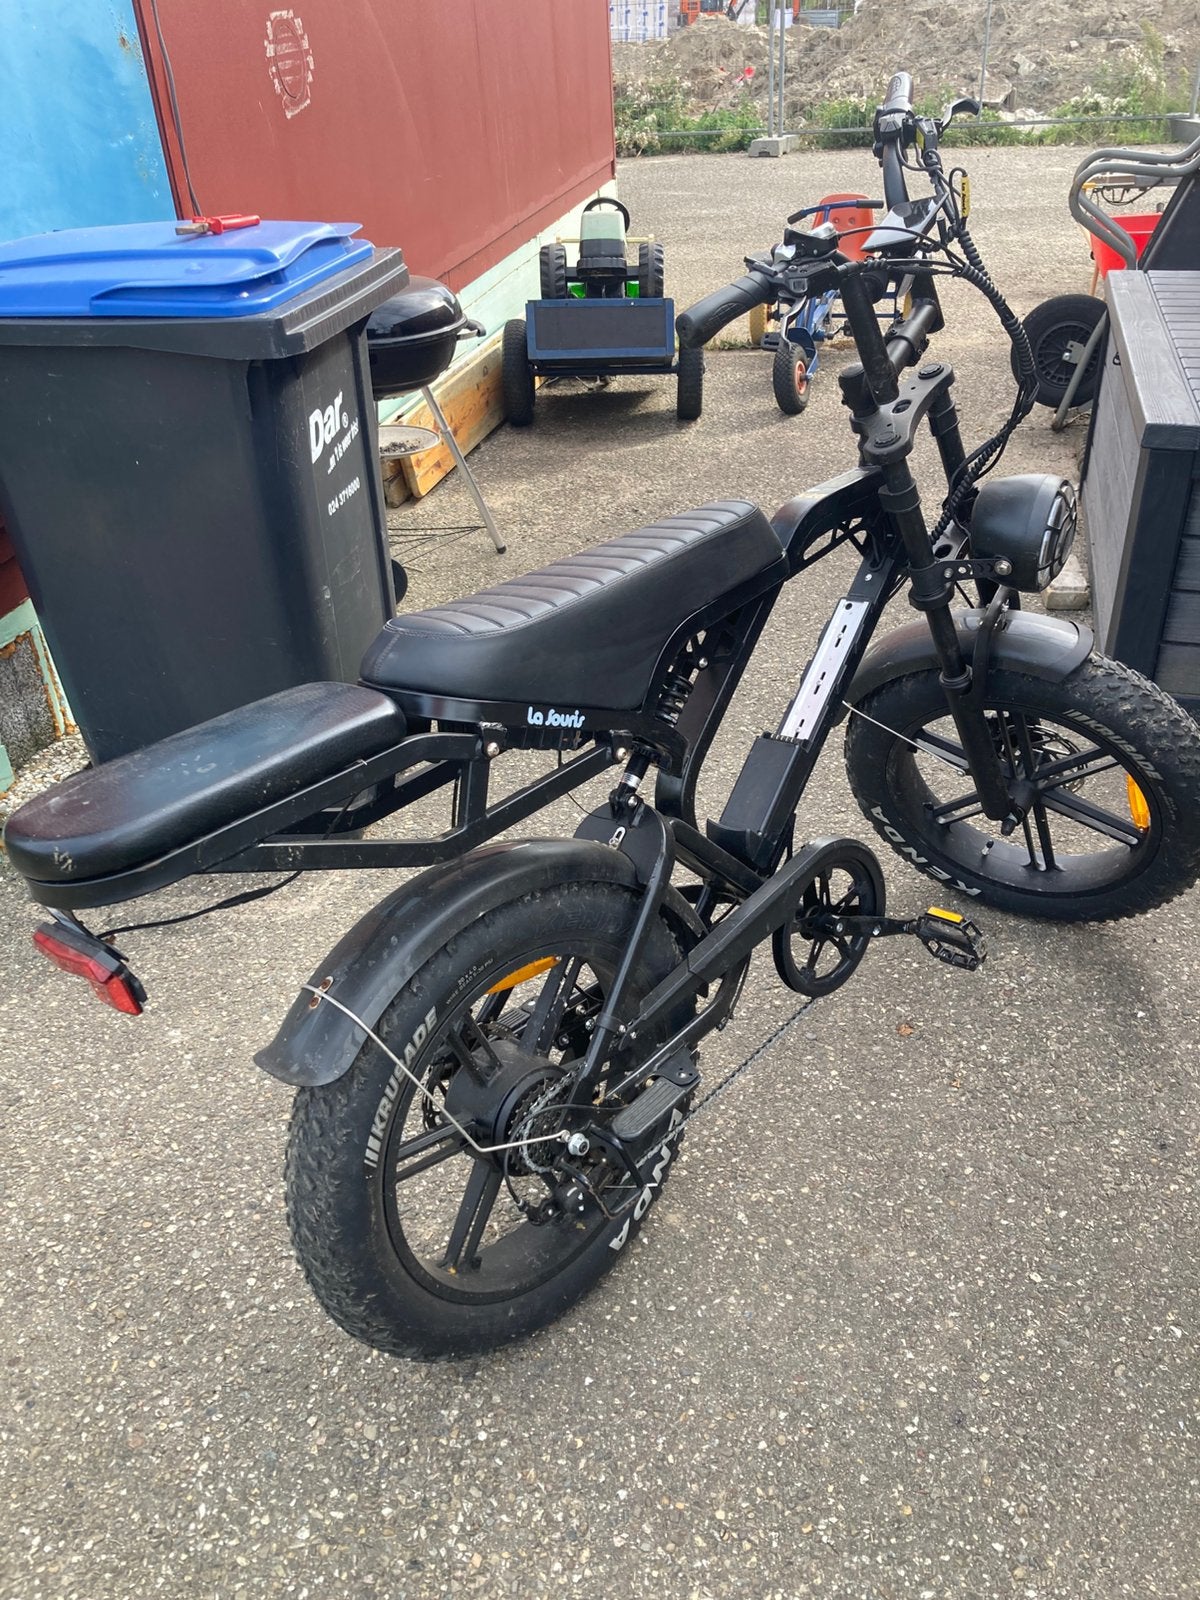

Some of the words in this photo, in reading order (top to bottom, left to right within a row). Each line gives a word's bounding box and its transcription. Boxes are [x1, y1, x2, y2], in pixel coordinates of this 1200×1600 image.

[527, 706, 544, 725] La
[545, 708, 586, 729] Souris
[870, 806, 982, 897] KENDA
[371, 1005, 438, 1140] KRUSADE
